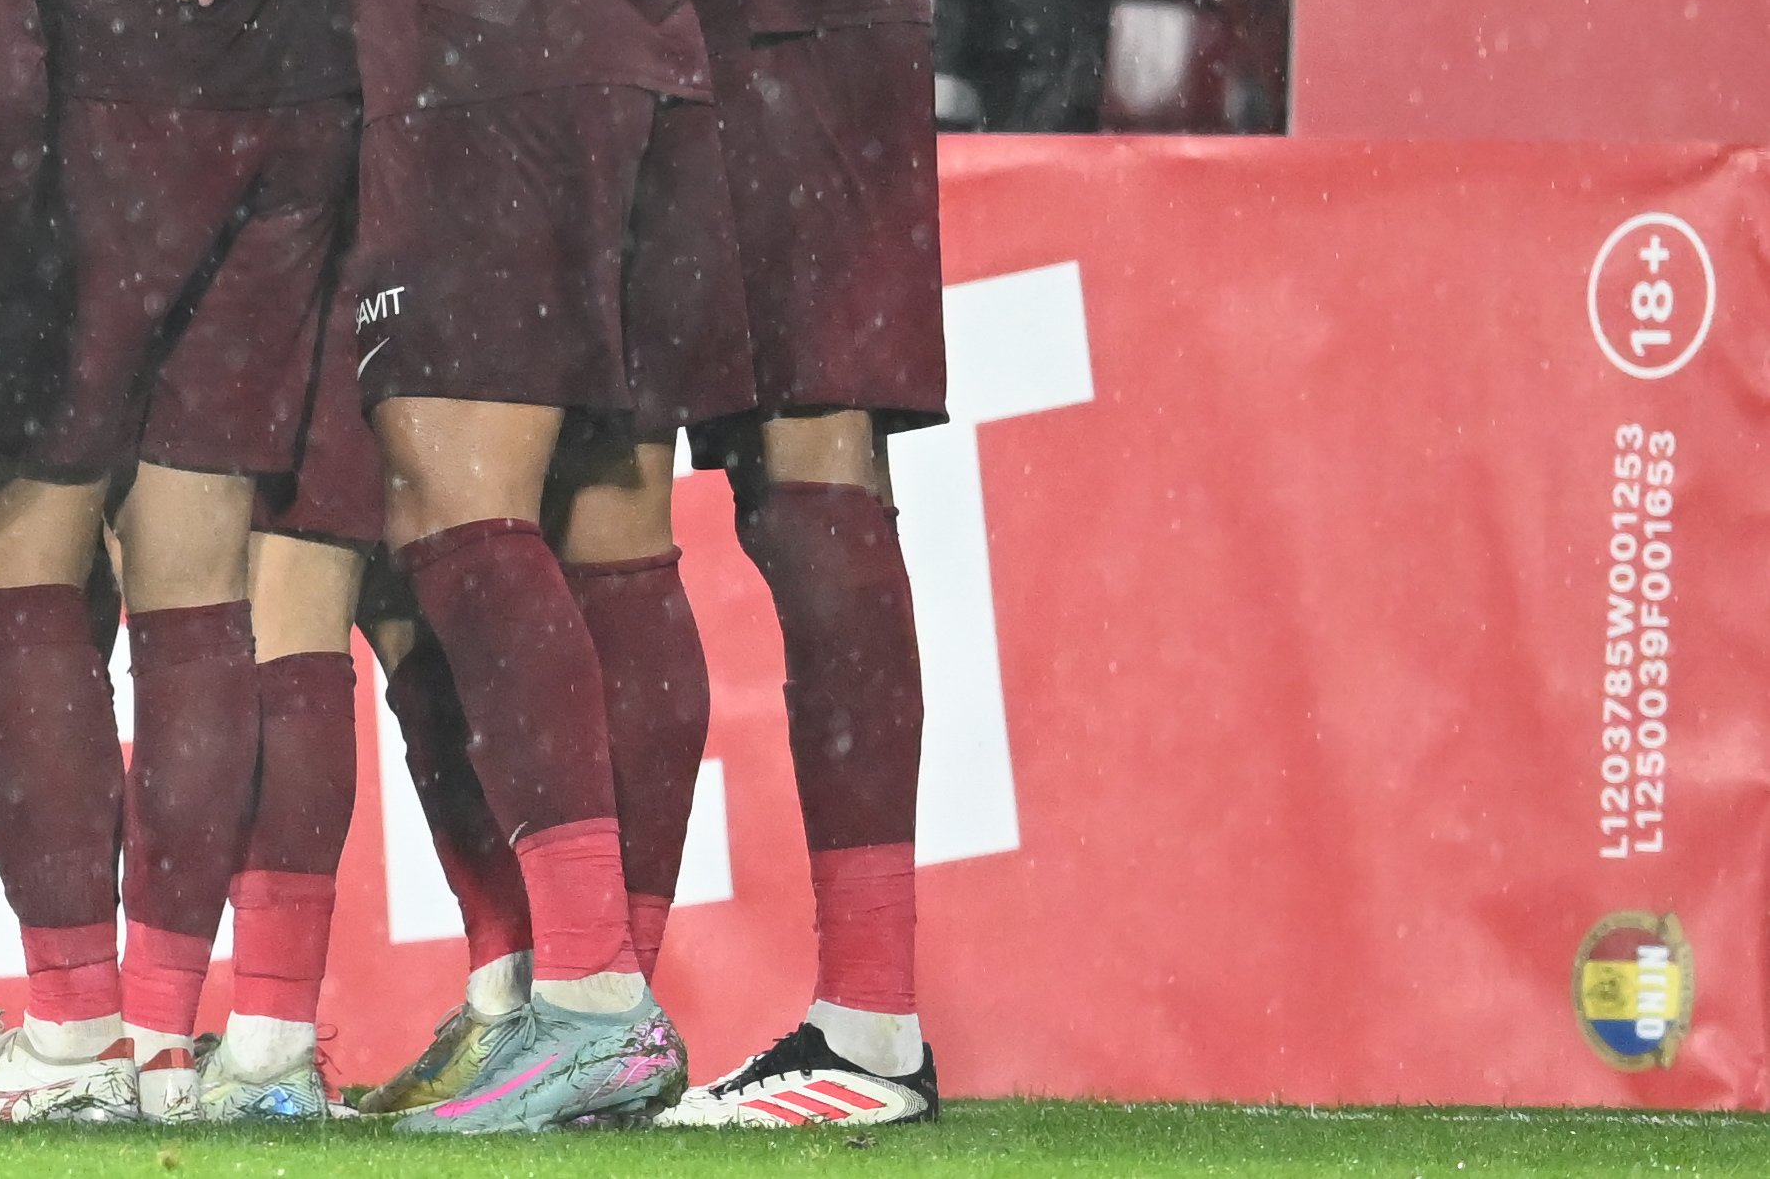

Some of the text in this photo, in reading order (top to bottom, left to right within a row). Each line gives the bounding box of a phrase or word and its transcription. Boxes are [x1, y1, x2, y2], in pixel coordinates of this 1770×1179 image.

[355, 286, 406, 335] AVIT
[1630, 234, 1674, 357] 18+
[1599, 422, 1644, 859] L1203785W001253
[1634, 429, 1676, 854] L1250039F001653
